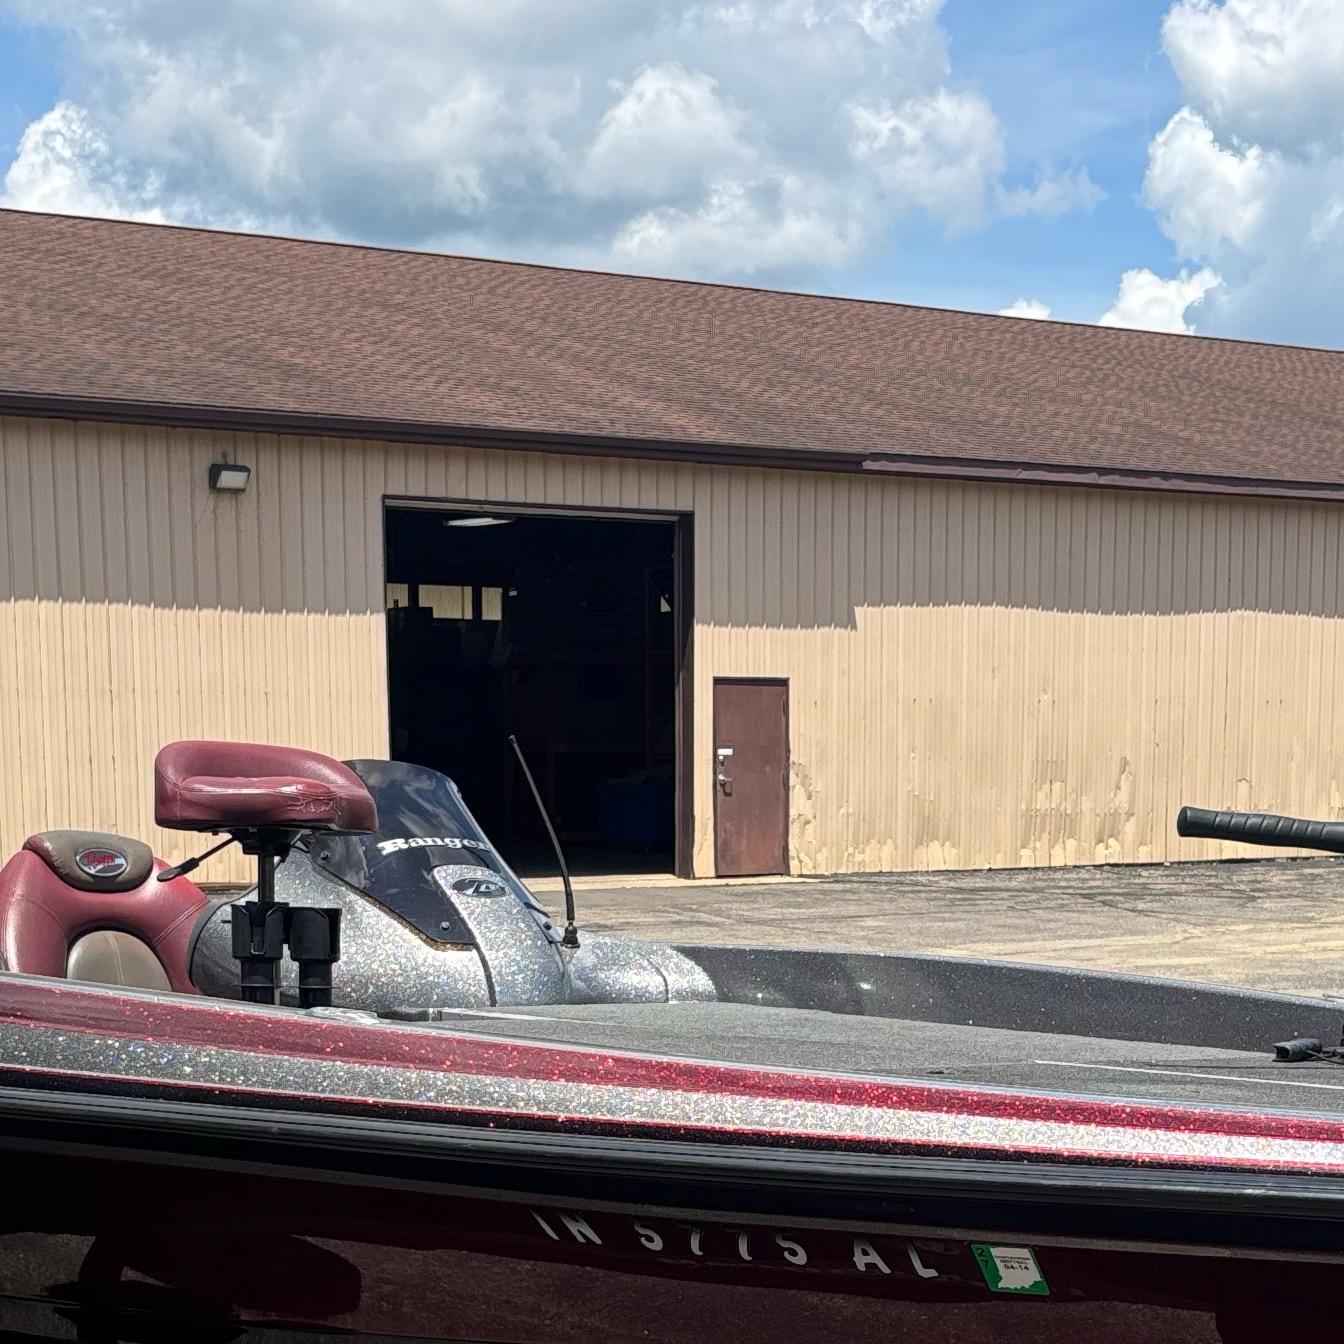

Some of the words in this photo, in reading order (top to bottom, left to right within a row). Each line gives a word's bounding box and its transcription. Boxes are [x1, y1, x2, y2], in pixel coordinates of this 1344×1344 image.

[376, 837, 491, 856] Ranger
[529, 1207, 603, 1245] IN
[631, 1218, 808, 1266] 5775
[849, 1234, 940, 1279] AL
